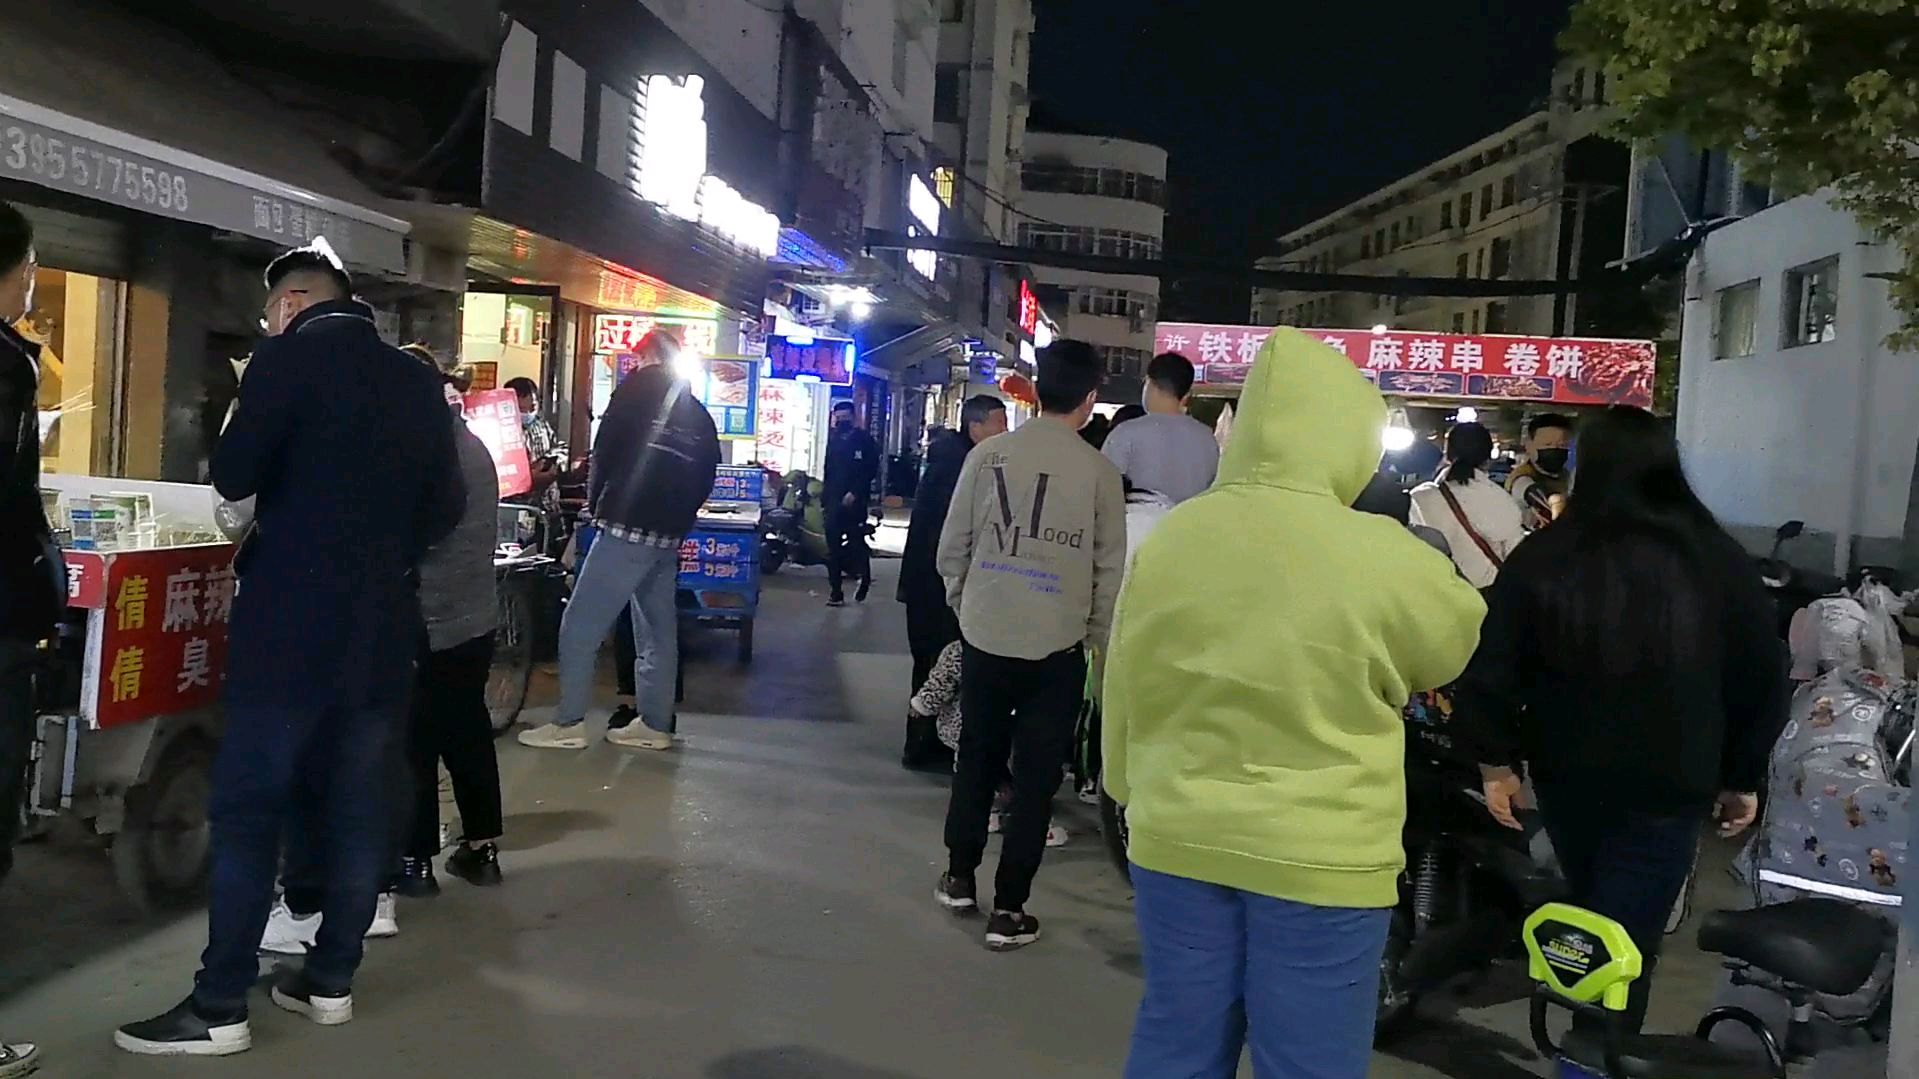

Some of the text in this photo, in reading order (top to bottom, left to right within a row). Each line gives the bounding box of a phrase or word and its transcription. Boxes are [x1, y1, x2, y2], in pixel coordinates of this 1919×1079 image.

[1366, 337, 1483, 373] 麻辣串
[1503, 343, 1584, 379] 卷饼
